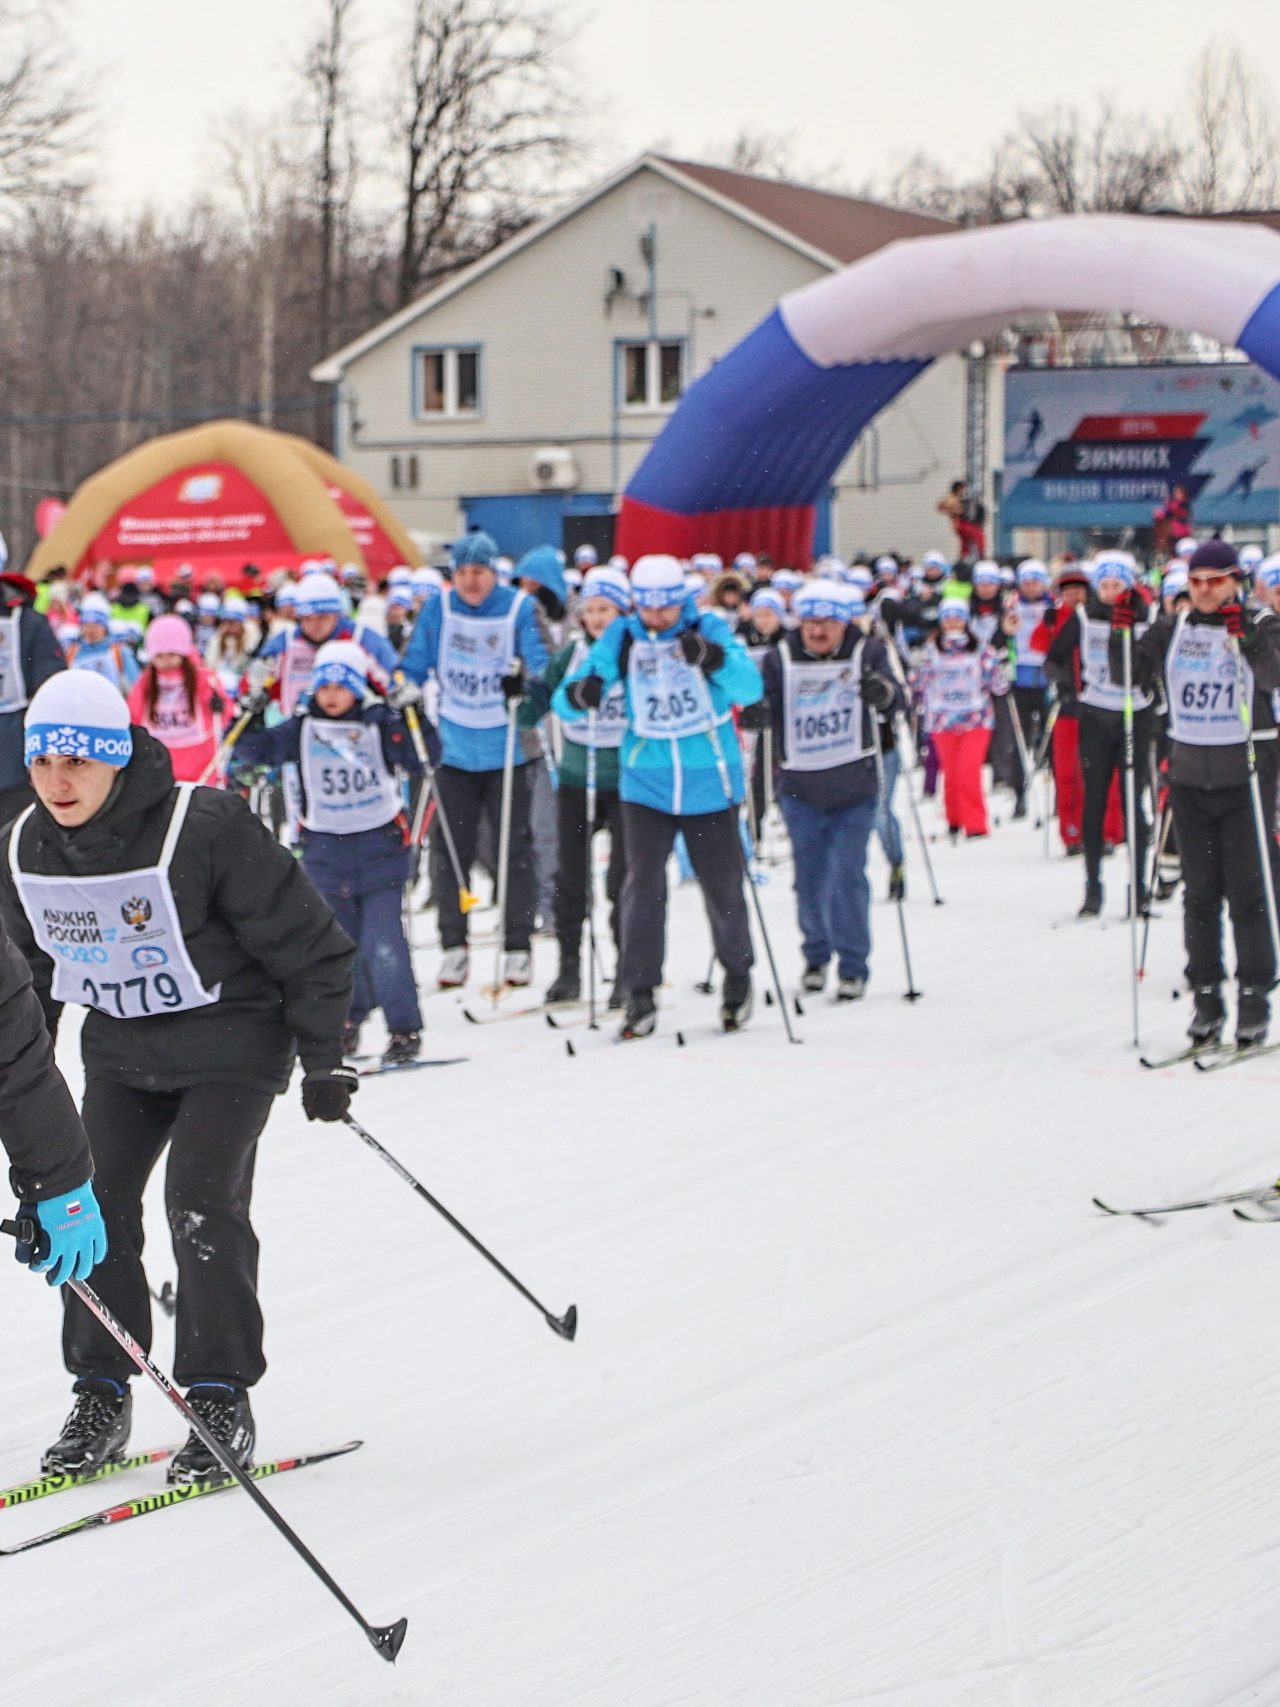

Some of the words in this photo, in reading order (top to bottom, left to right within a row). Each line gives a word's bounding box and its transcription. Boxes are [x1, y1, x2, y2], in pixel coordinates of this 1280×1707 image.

[1075, 445, 1170, 471] ЗИМНИХ
[1182, 683, 1234, 710] 6571
[794, 709, 852, 740] 10637
[323, 768, 380, 796] 5304
[43, 909, 98, 926] ЛЫЖНЯ
[47, 924, 103, 943] РОССИИ
